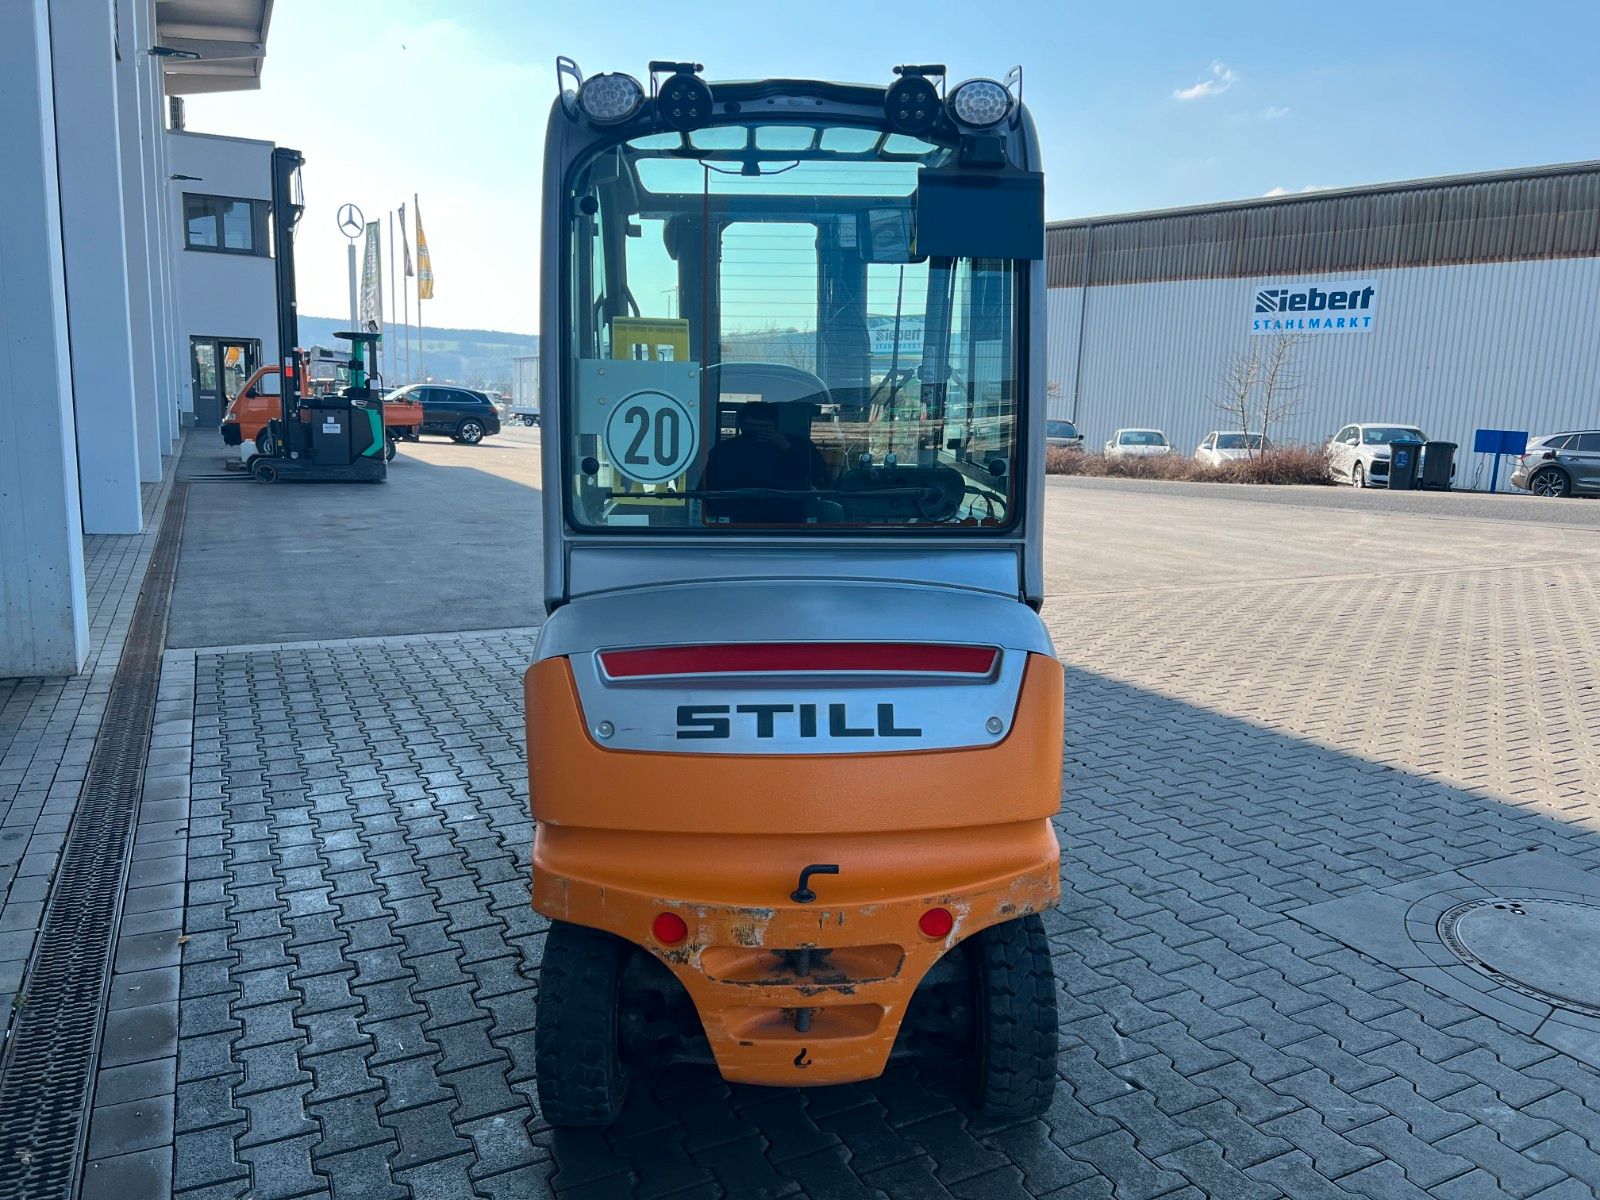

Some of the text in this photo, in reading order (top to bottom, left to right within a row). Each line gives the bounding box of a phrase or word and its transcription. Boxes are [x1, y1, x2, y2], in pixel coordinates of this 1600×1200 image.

[1255, 286, 1375, 313] Siebert
[1253, 316, 1371, 330] STAHLMARKT
[624, 405, 680, 466] 20
[676, 703, 923, 739] STILL
